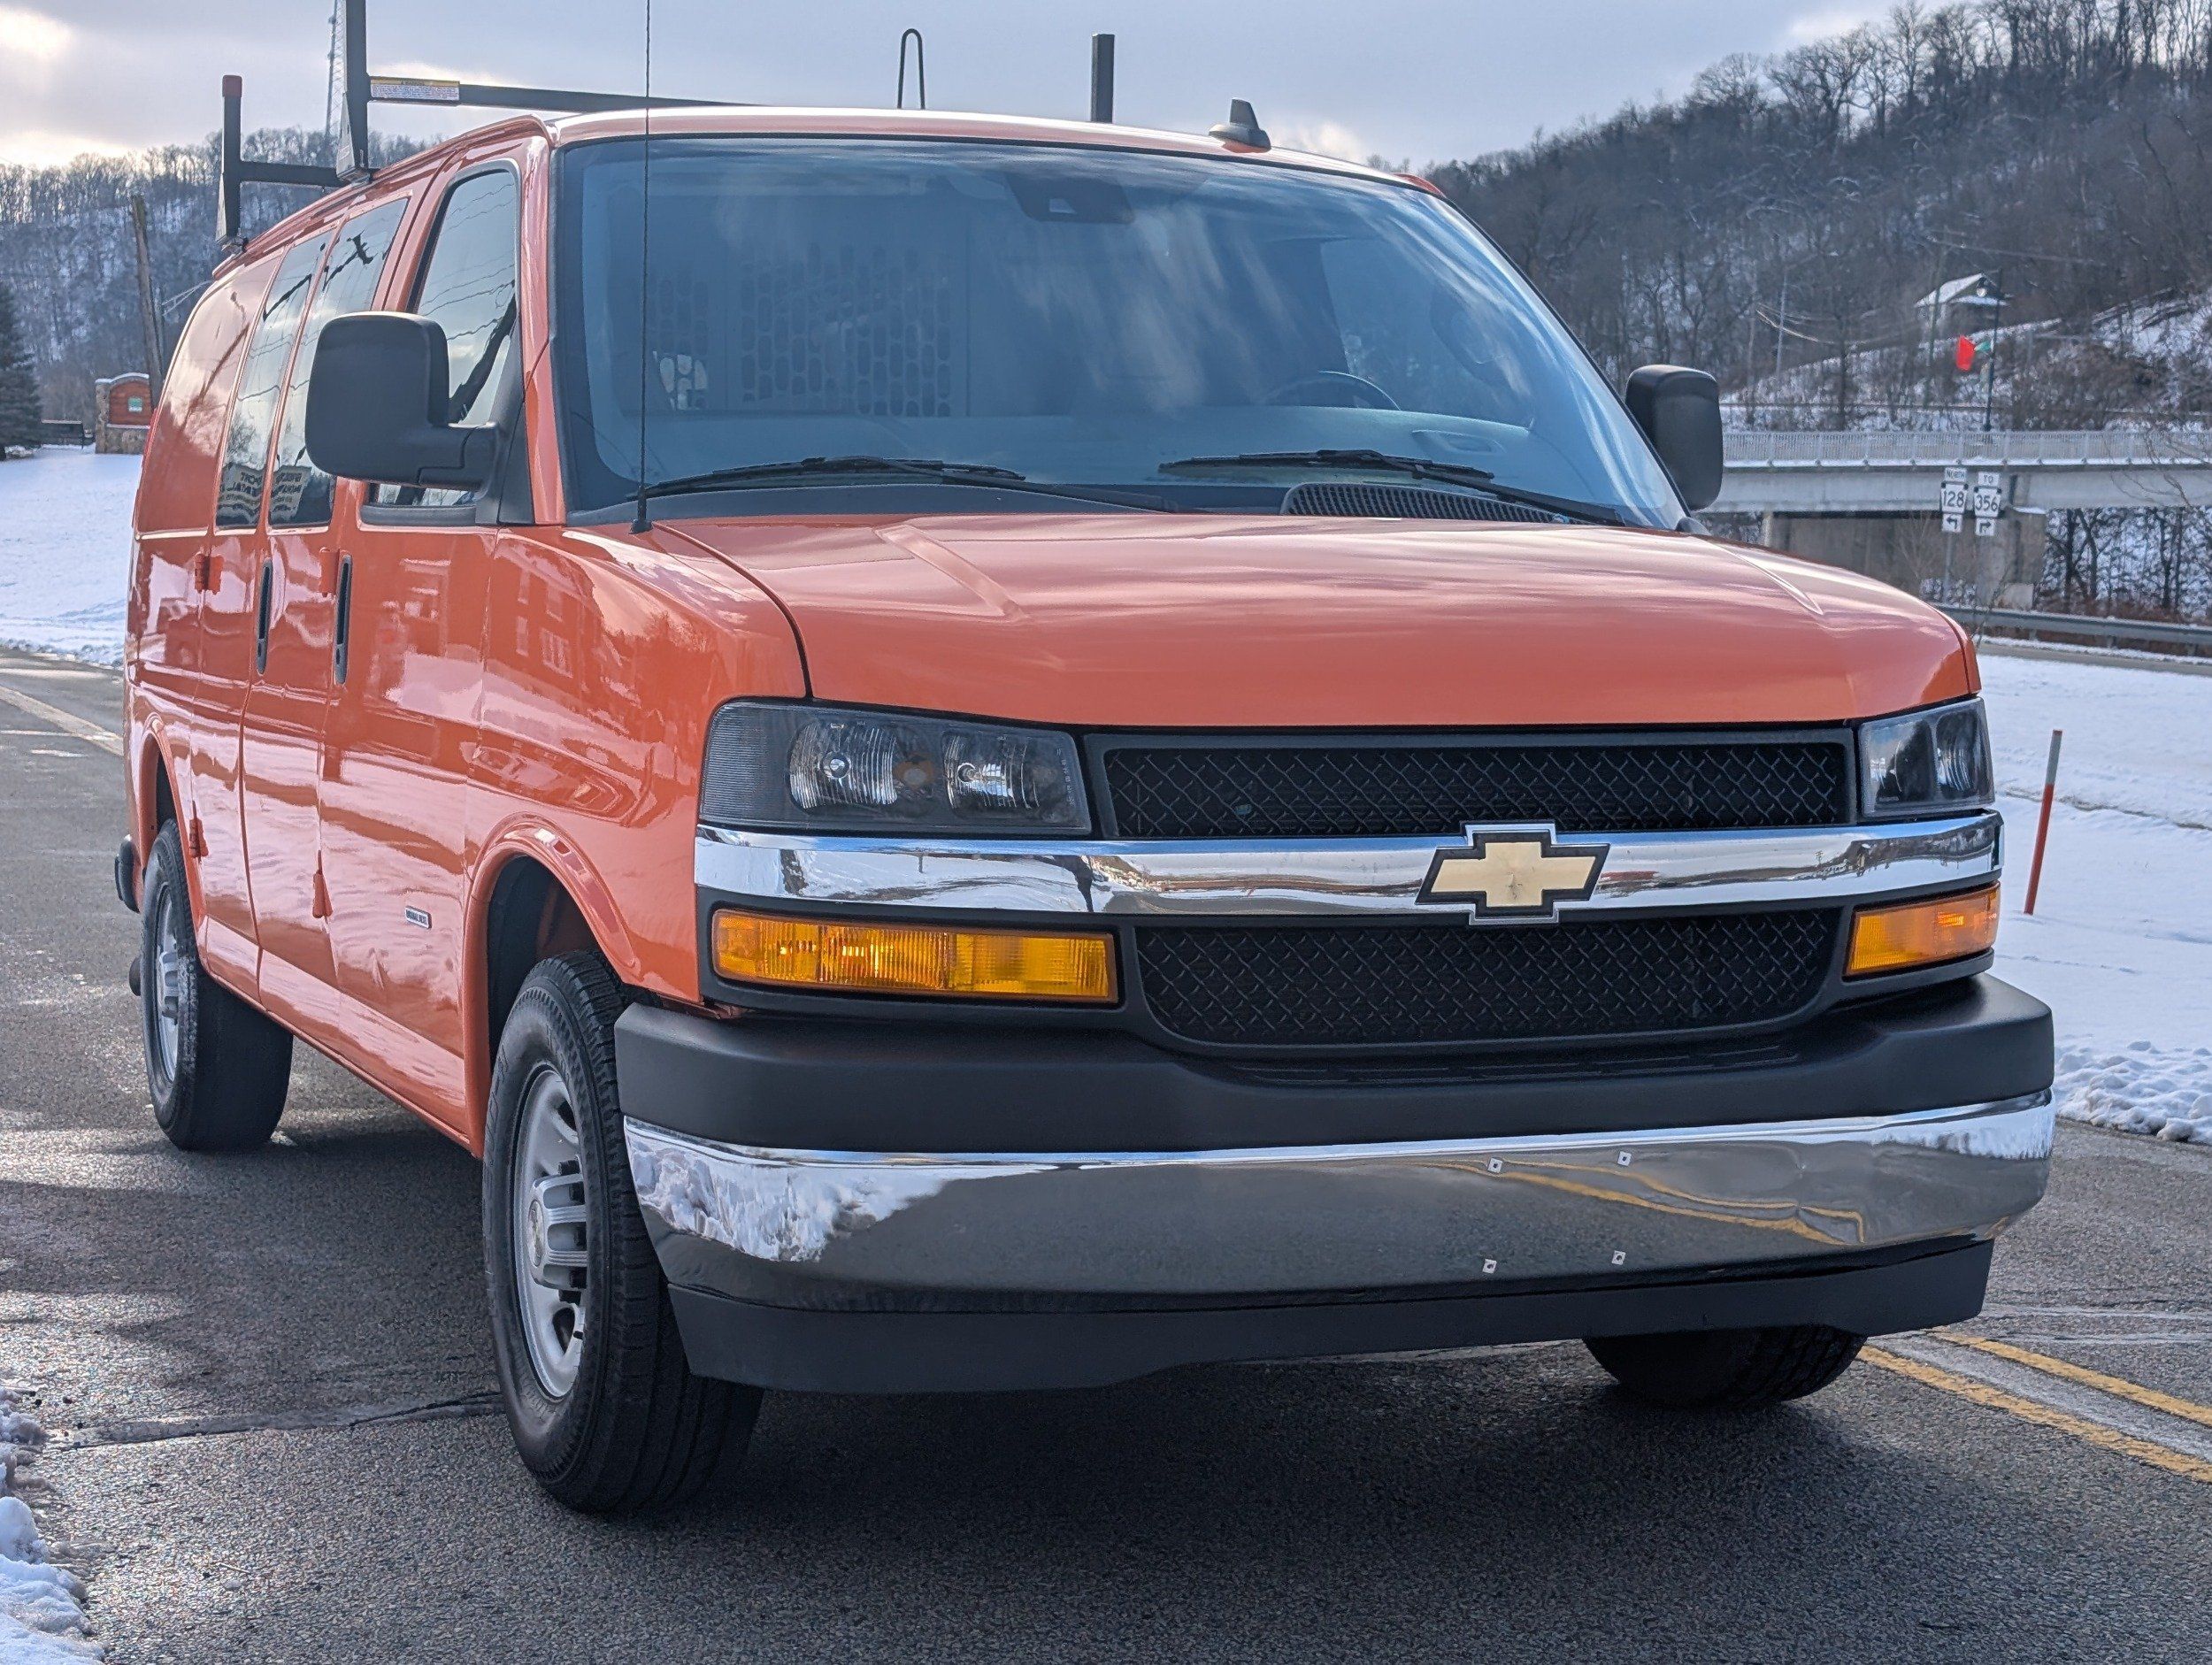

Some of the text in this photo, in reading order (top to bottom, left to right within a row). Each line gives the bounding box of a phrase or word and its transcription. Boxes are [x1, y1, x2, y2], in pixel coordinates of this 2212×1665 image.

[1984, 474, 1993, 483] TO
[1943, 490, 1964, 508] 128
[1975, 495, 1999, 512] 356
